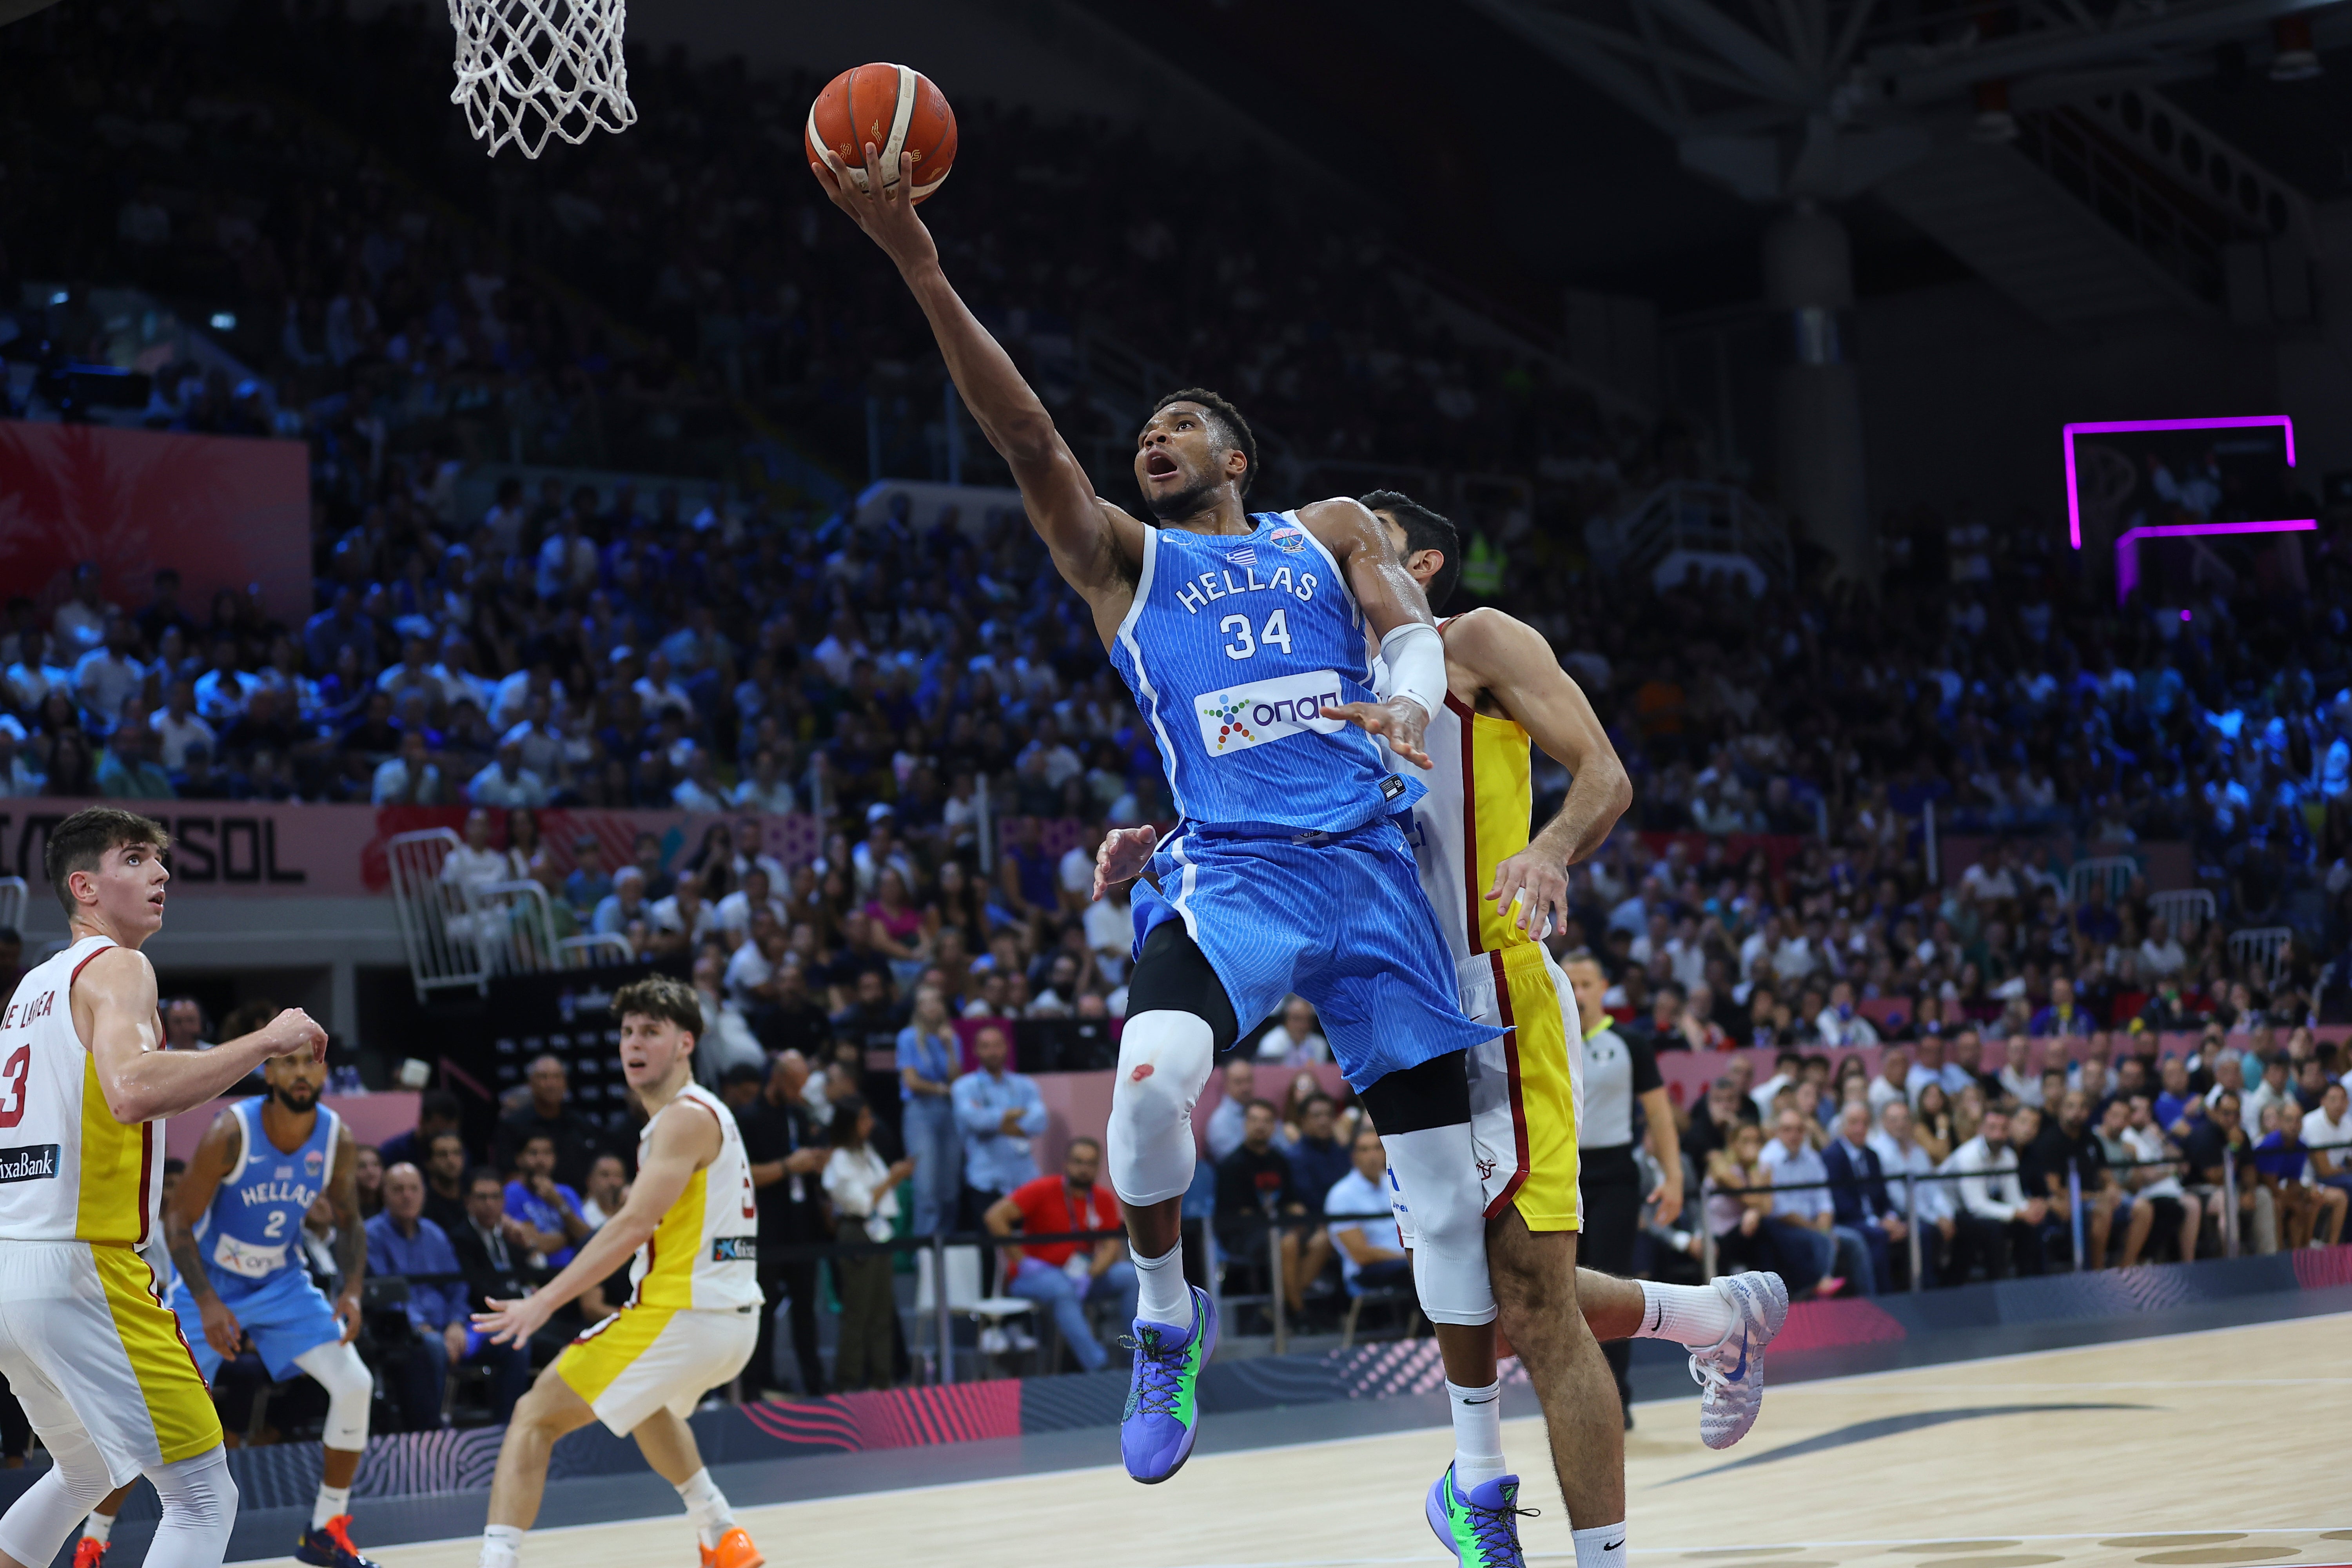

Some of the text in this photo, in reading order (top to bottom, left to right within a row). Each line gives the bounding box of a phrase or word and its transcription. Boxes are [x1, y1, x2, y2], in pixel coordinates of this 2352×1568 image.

[1175, 566, 1318, 615] HELLAS
[1219, 608, 1292, 660] 34
[1394, 779, 1403, 788] 50
[240, 1181, 318, 1208] HELLAS
[263, 1210, 287, 1239] 2
